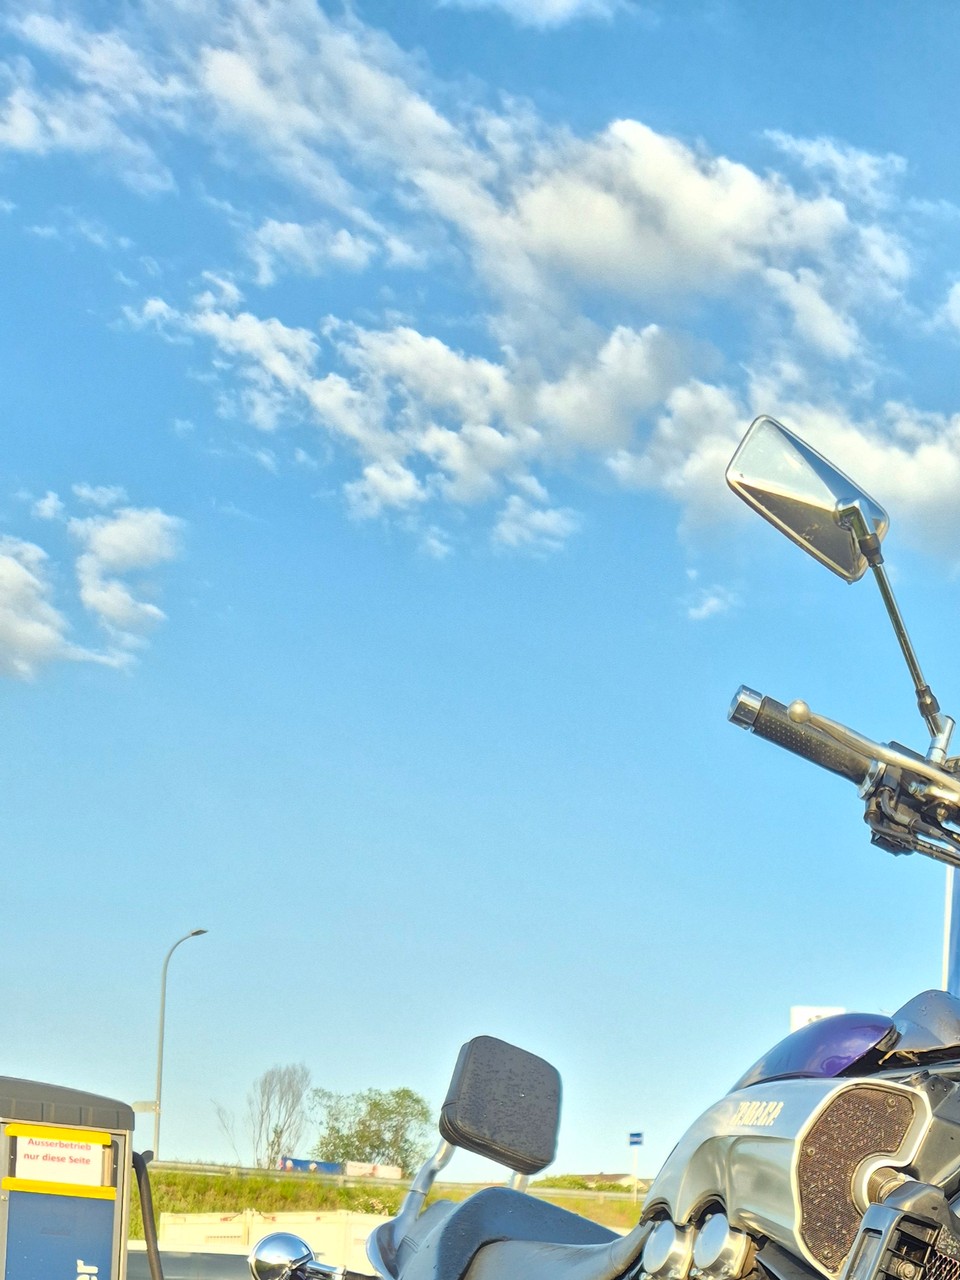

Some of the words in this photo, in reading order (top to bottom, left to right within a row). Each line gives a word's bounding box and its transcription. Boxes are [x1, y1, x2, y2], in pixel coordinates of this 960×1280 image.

[27, 1138, 92, 1151] Ausserbetrieb
[42, 1153, 66, 1162] diese
[69, 1155, 91, 1165] Seite
